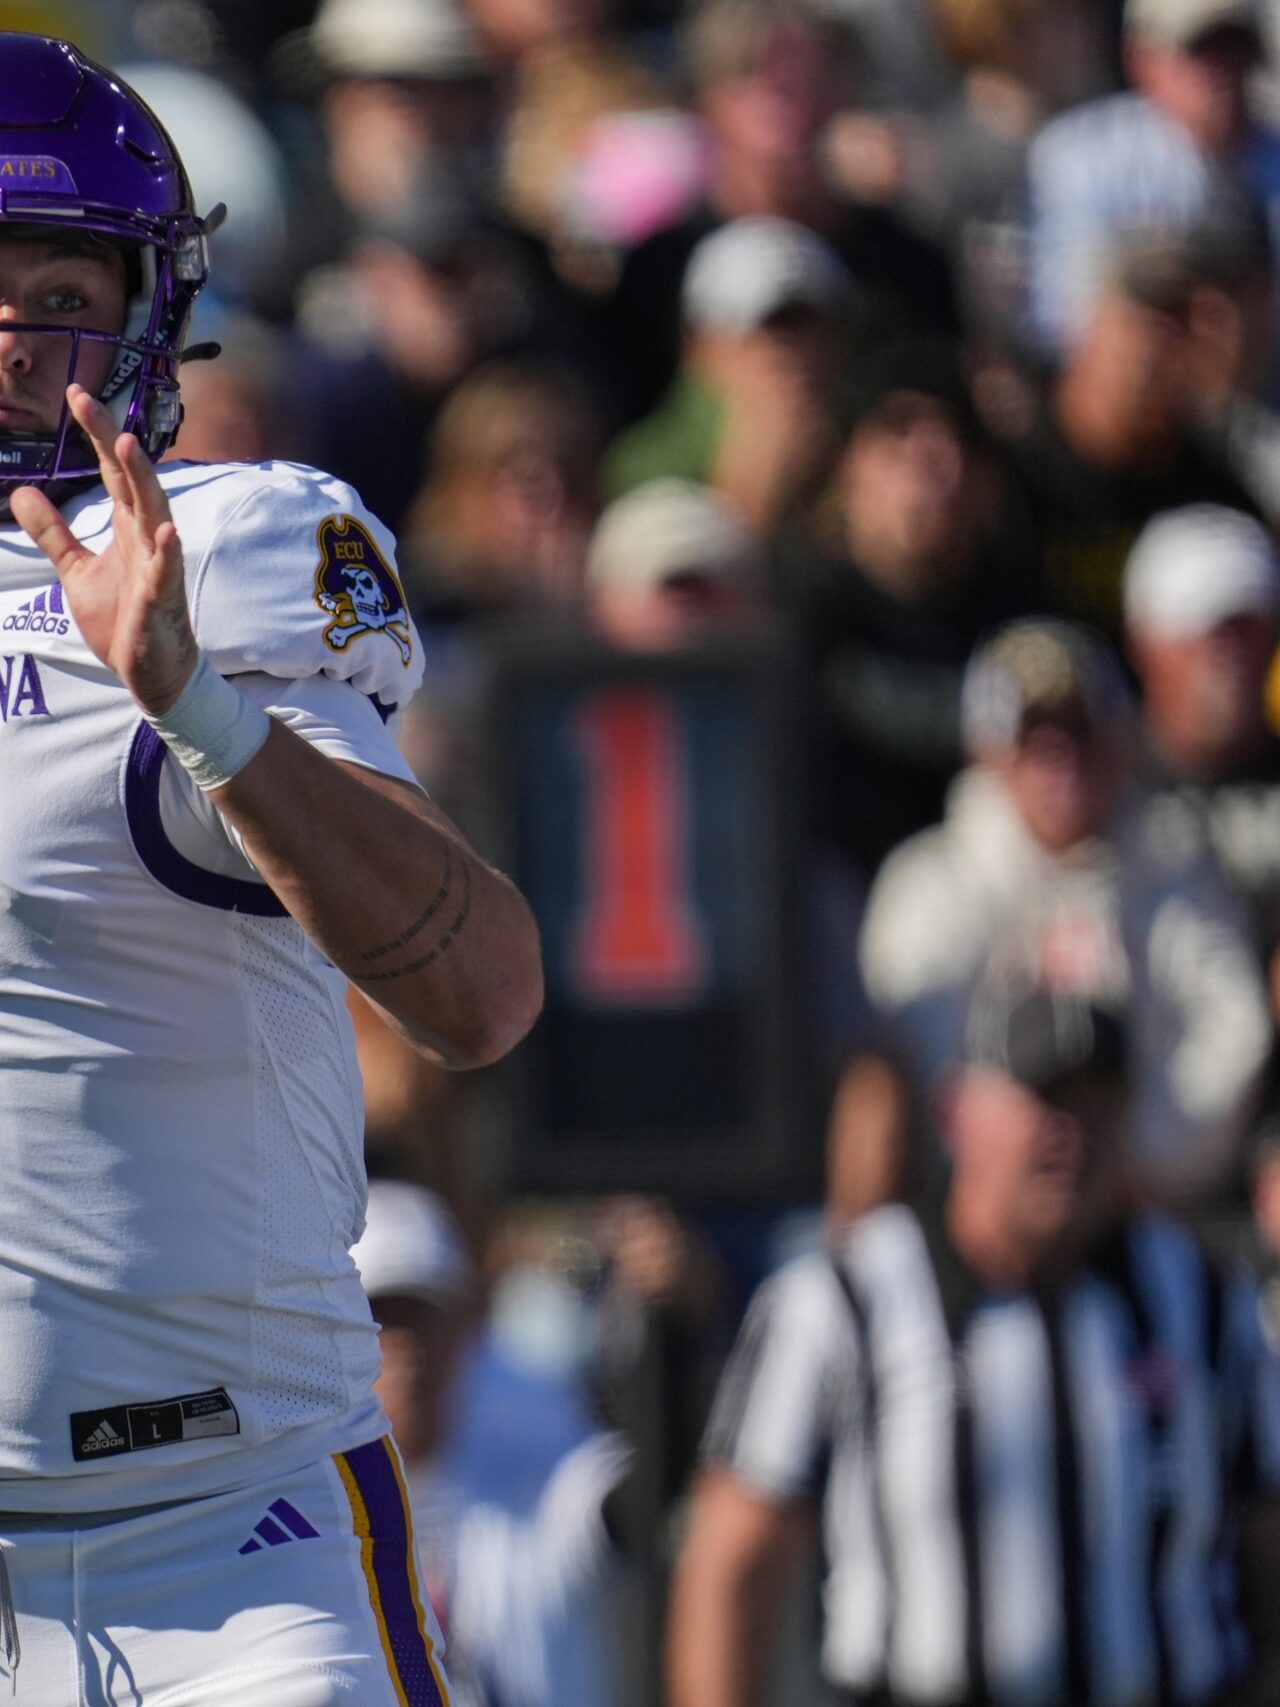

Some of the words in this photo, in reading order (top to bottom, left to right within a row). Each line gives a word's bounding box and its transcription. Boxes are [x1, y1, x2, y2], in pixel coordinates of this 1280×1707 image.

[333, 541, 365, 560] ECU
[2, 609, 71, 636] adidas
[151, 1423, 162, 1440] L
[81, 1435, 125, 1453] adidas
